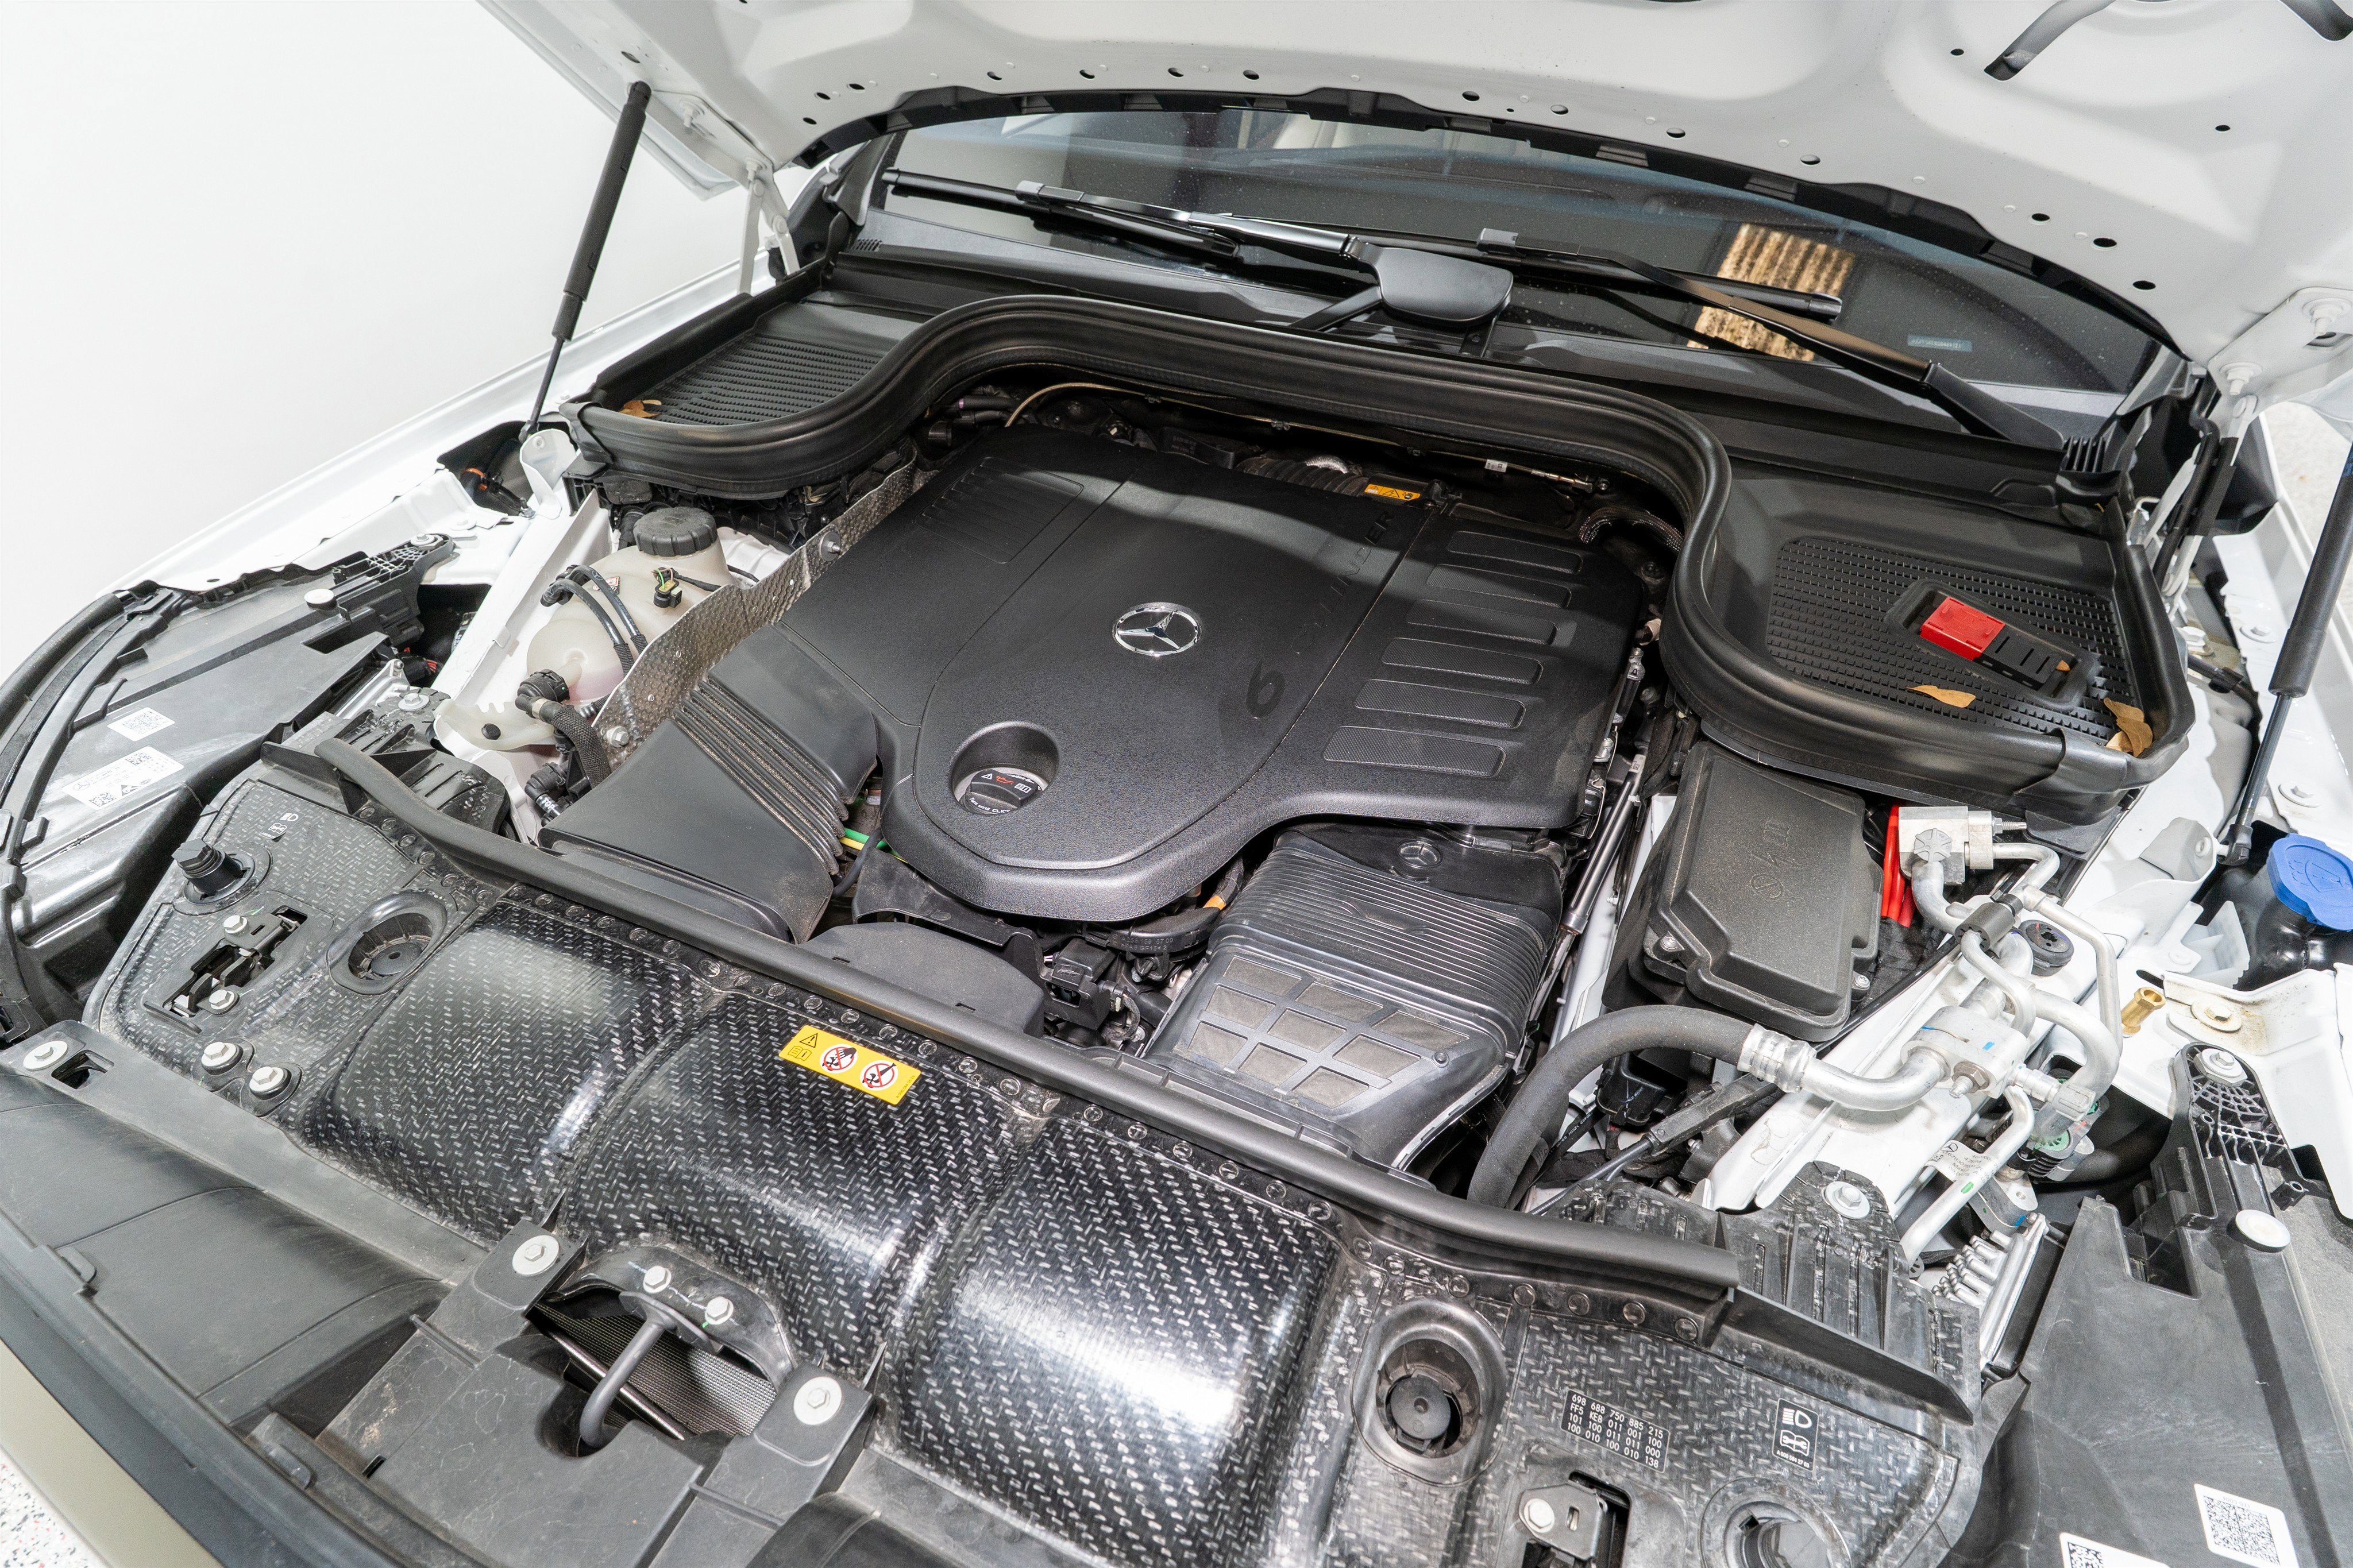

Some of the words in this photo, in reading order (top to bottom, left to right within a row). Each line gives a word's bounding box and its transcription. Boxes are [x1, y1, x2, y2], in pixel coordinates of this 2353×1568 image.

[1246, 658, 1285, 719] 6
[542, 797, 556, 809] TOP
[969, 797, 978, 805] Turn
[1569, 1413, 1582, 1424] 101
[1588, 1421, 1602, 1433] 100
[1606, 1429, 1620, 1441] 011
[1626, 1438, 1640, 1449] 011
[1645, 1447, 1660, 1458] 000
[1571, 1403, 1583, 1415] FF5
[1590, 1411, 1603, 1423] KE8
[1608, 1420, 1622, 1431] 011
[1627, 1428, 1641, 1440] 001
[1648, 1436, 1661, 1448] 100
[1572, 1395, 1586, 1406] 698
[1591, 1403, 1605, 1414] 688
[1610, 1409, 1625, 1422] 750
[1629, 1418, 1644, 1430] 885
[1648, 1427, 1663, 1439] 215
[1568, 1423, 1581, 1434] 100
[1586, 1430, 1600, 1442] 010
[1606, 1439, 1619, 1451] 100
[1625, 1447, 1639, 1459] 010
[1645, 1456, 1658, 1468] 138
